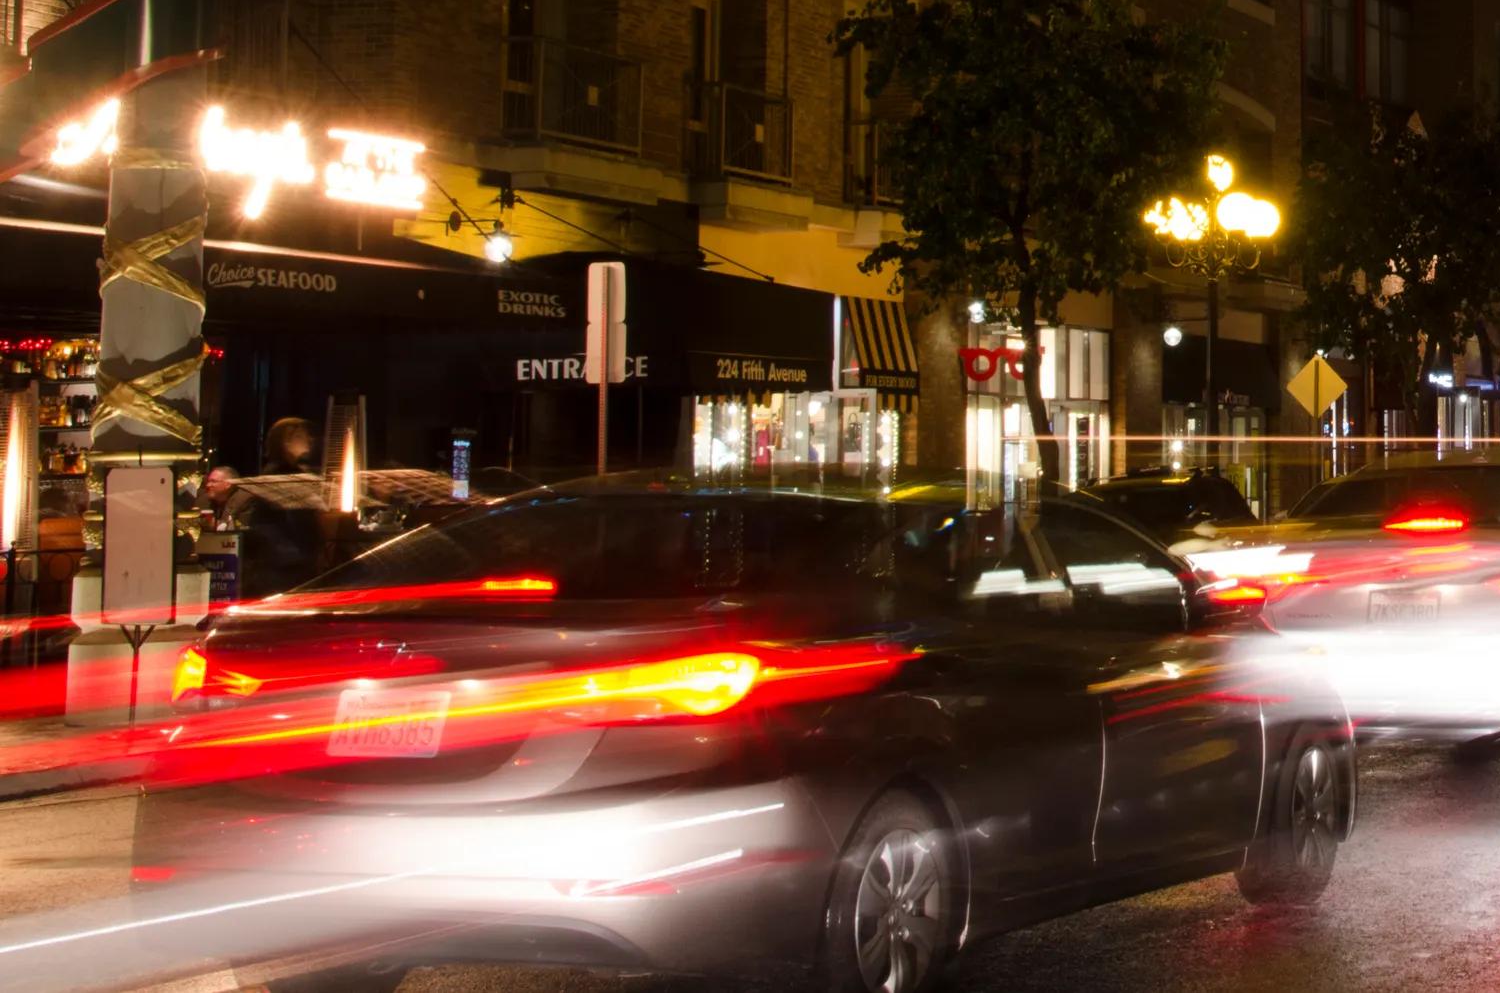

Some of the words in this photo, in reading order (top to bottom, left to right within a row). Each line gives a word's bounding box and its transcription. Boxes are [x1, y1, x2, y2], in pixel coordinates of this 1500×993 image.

[207, 262, 255, 286] Choice
[256, 267, 337, 293] SEAFOOD
[498, 290, 560, 306] EXOTIC
[499, 302, 566, 319] DRINKS
[717, 359, 739, 379] 224
[741, 360, 766, 381] Fifth
[768, 367, 808, 383] Avenue
